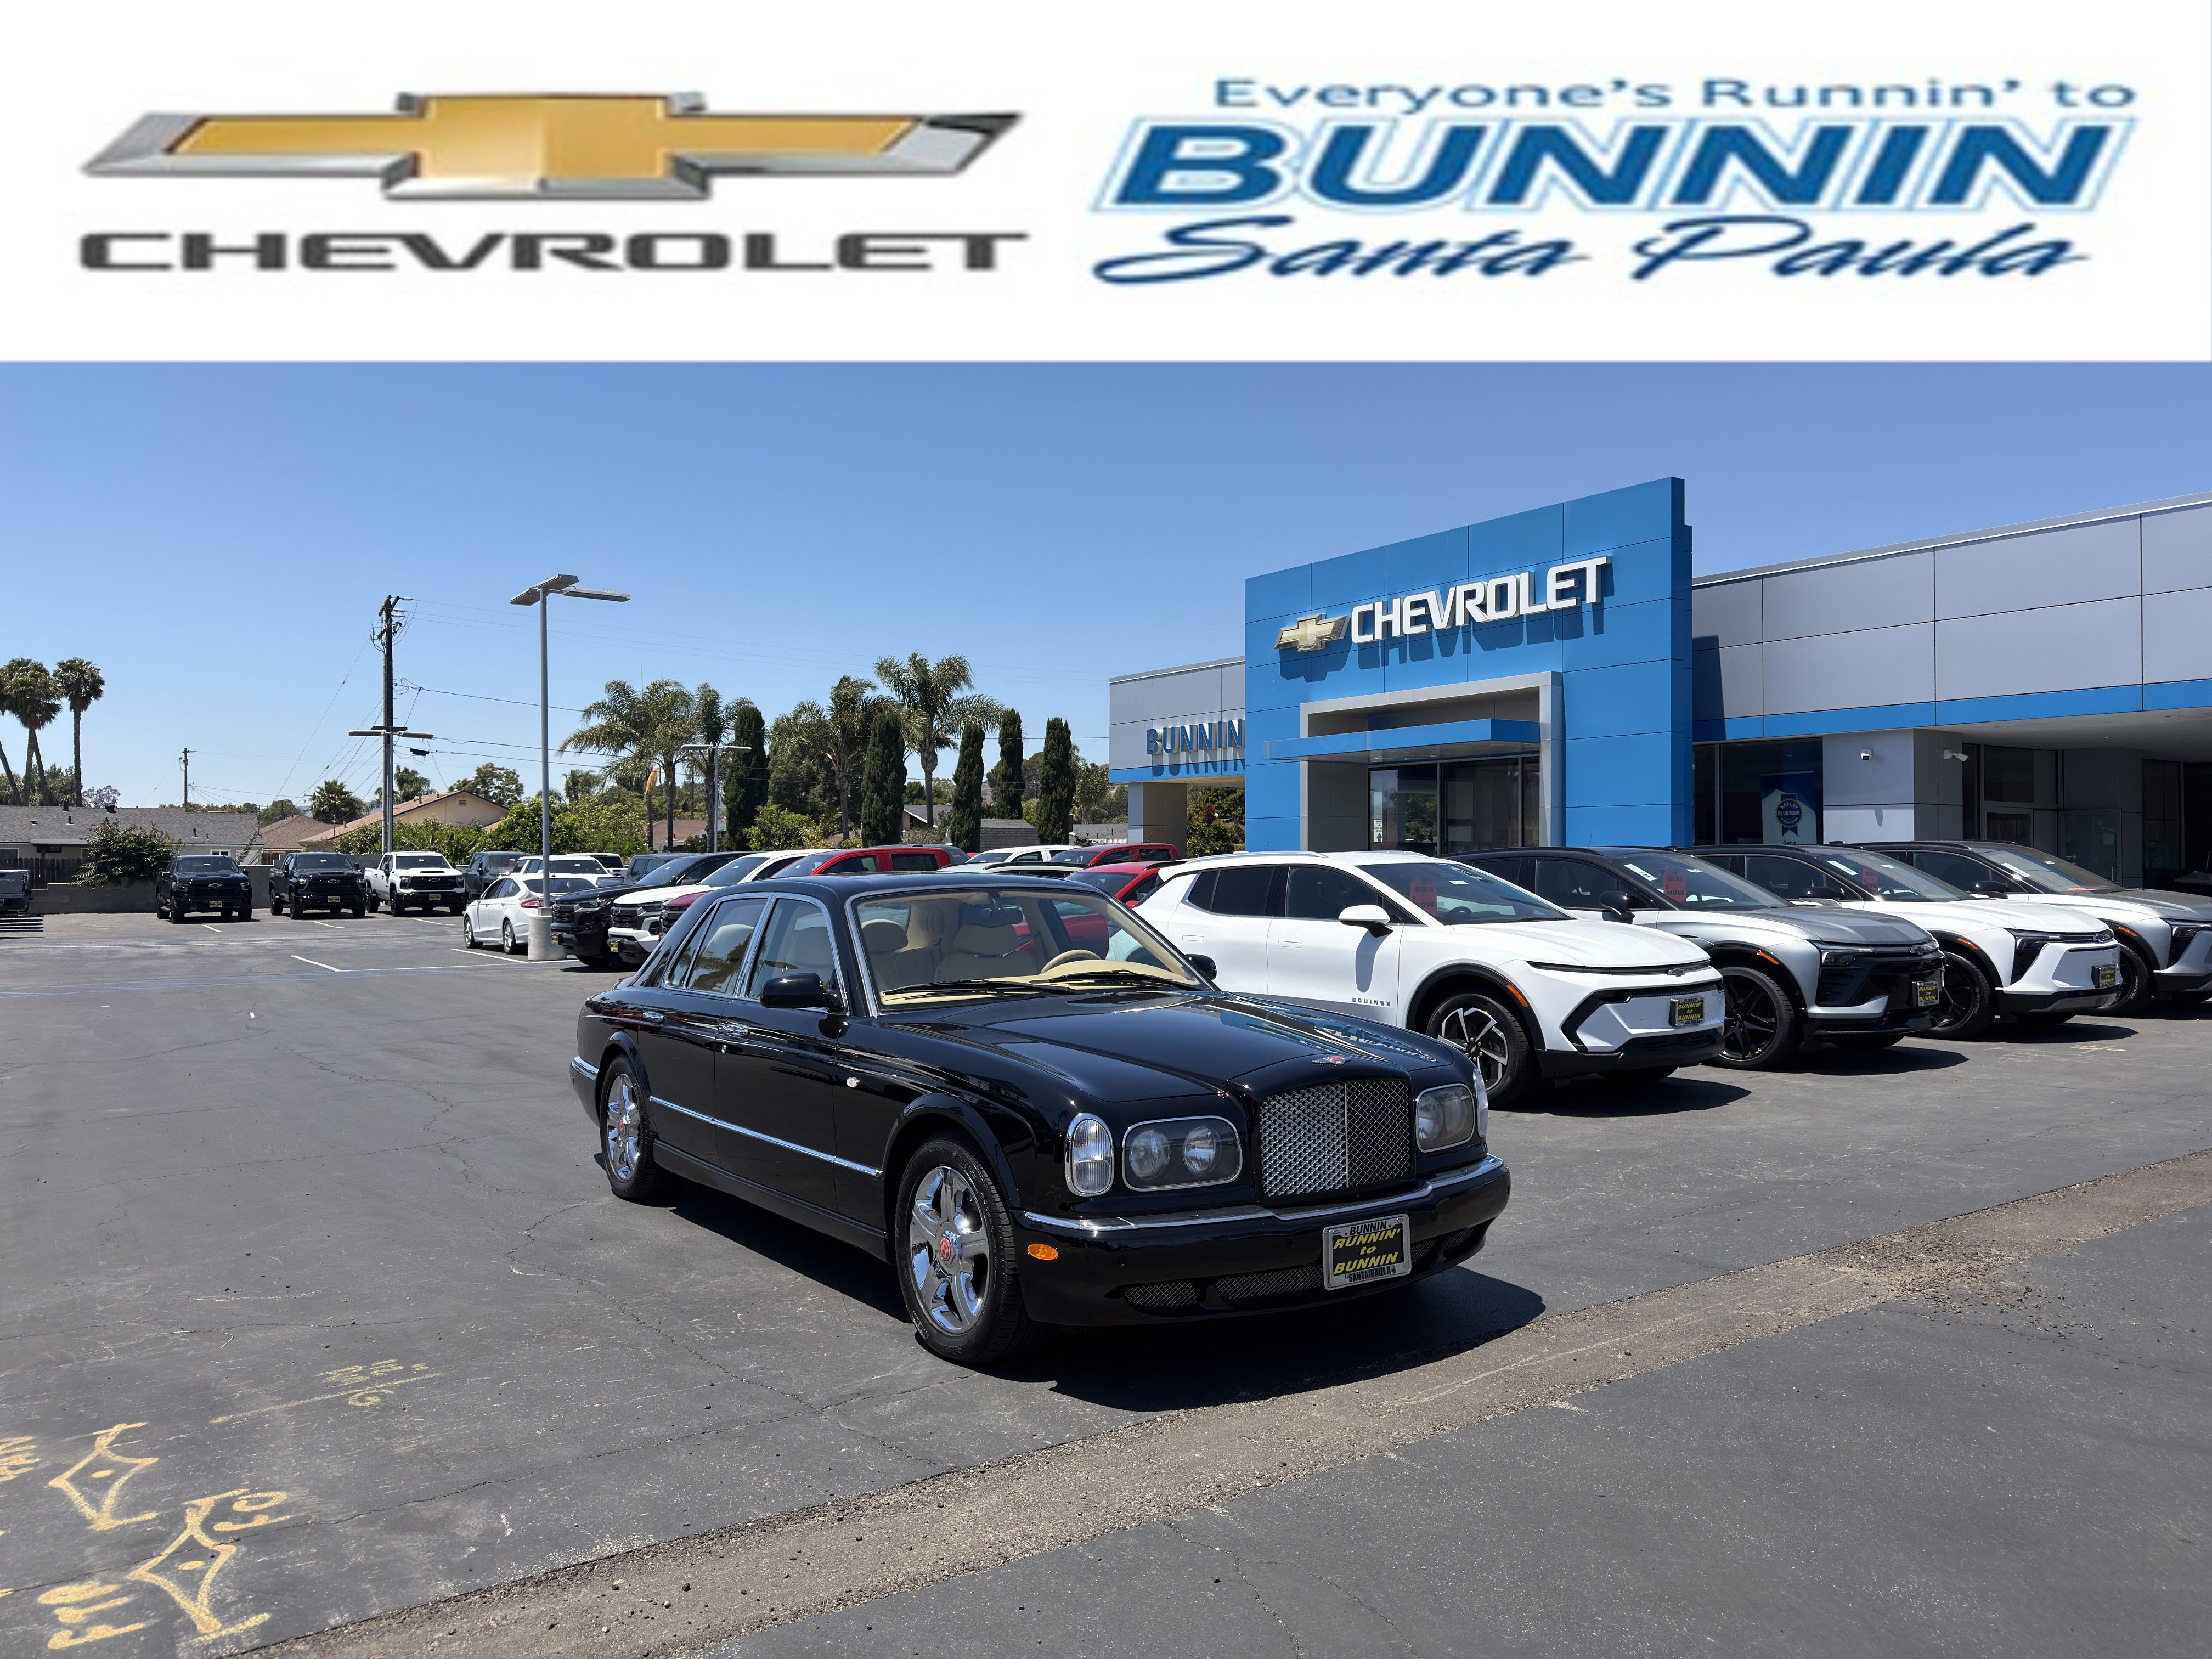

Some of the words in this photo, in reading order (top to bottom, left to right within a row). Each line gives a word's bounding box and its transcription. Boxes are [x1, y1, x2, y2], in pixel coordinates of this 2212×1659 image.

[1351, 556, 1612, 644] CHEVROLET
[1147, 719, 1245, 755] BUNNIN
[1333, 1228, 1401, 1250] RUNNIN'
[1349, 1221, 1387, 1235] BUNNIN
[1359, 1246, 1376, 1255] to
[1334, 1252, 1398, 1275] BUNNIN
[1348, 1269, 1369, 1282] SANTA
[1370, 1266, 1391, 1278] PAULA
